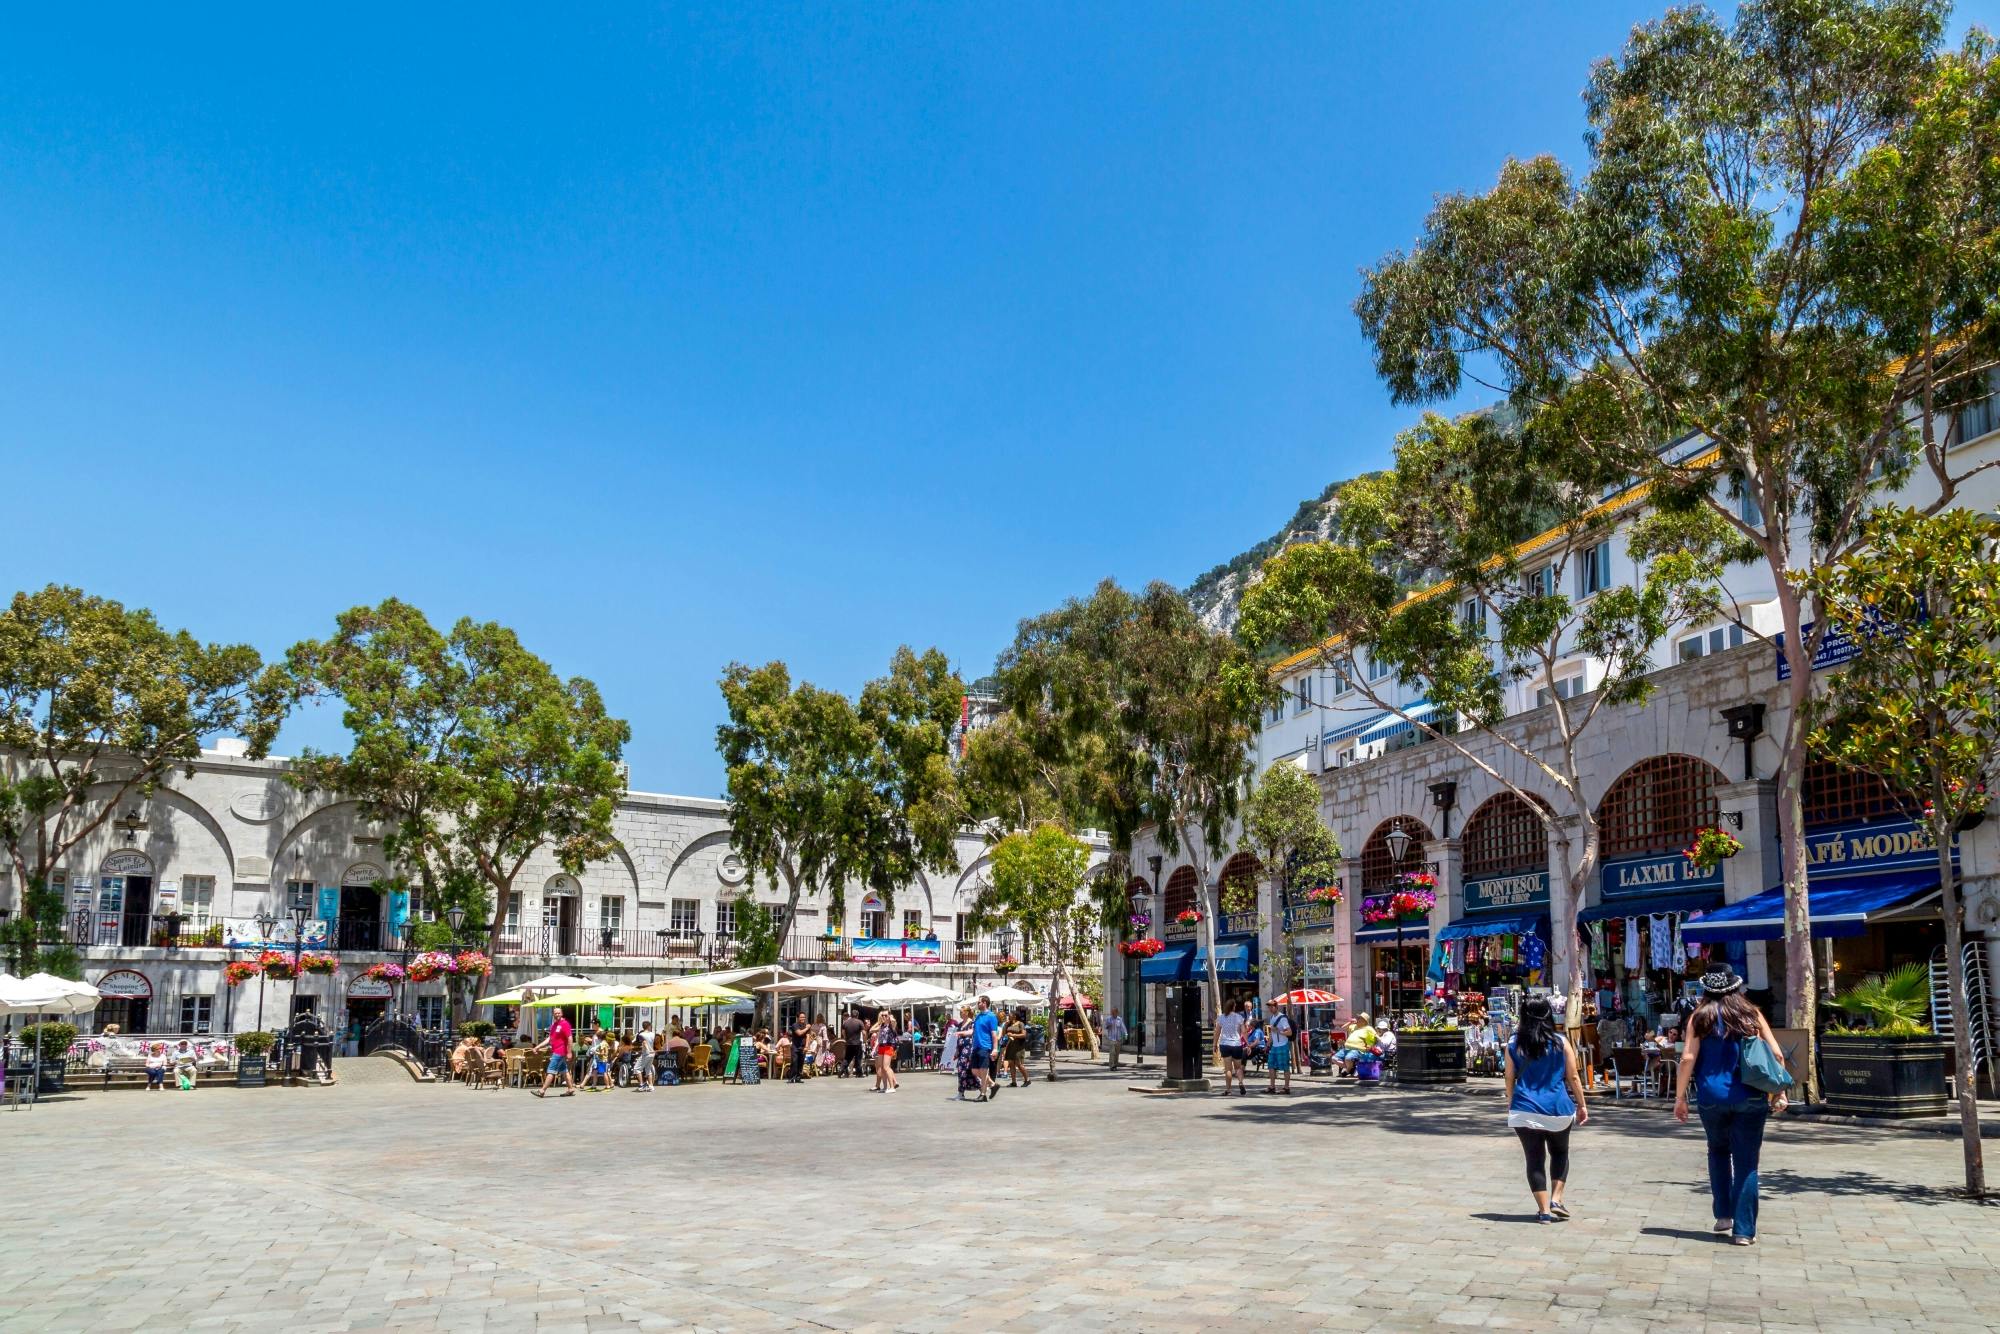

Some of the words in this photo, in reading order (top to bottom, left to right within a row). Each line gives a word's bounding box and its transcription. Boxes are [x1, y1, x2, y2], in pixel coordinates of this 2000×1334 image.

[1619, 863, 1676, 887] LAXMI
[1478, 876, 1544, 899] MONTESOL
[1491, 896, 1510, 905] GIFT
[1511, 893, 1531, 903] SHOP
[1839, 1069, 1872, 1077] CASEMATES
